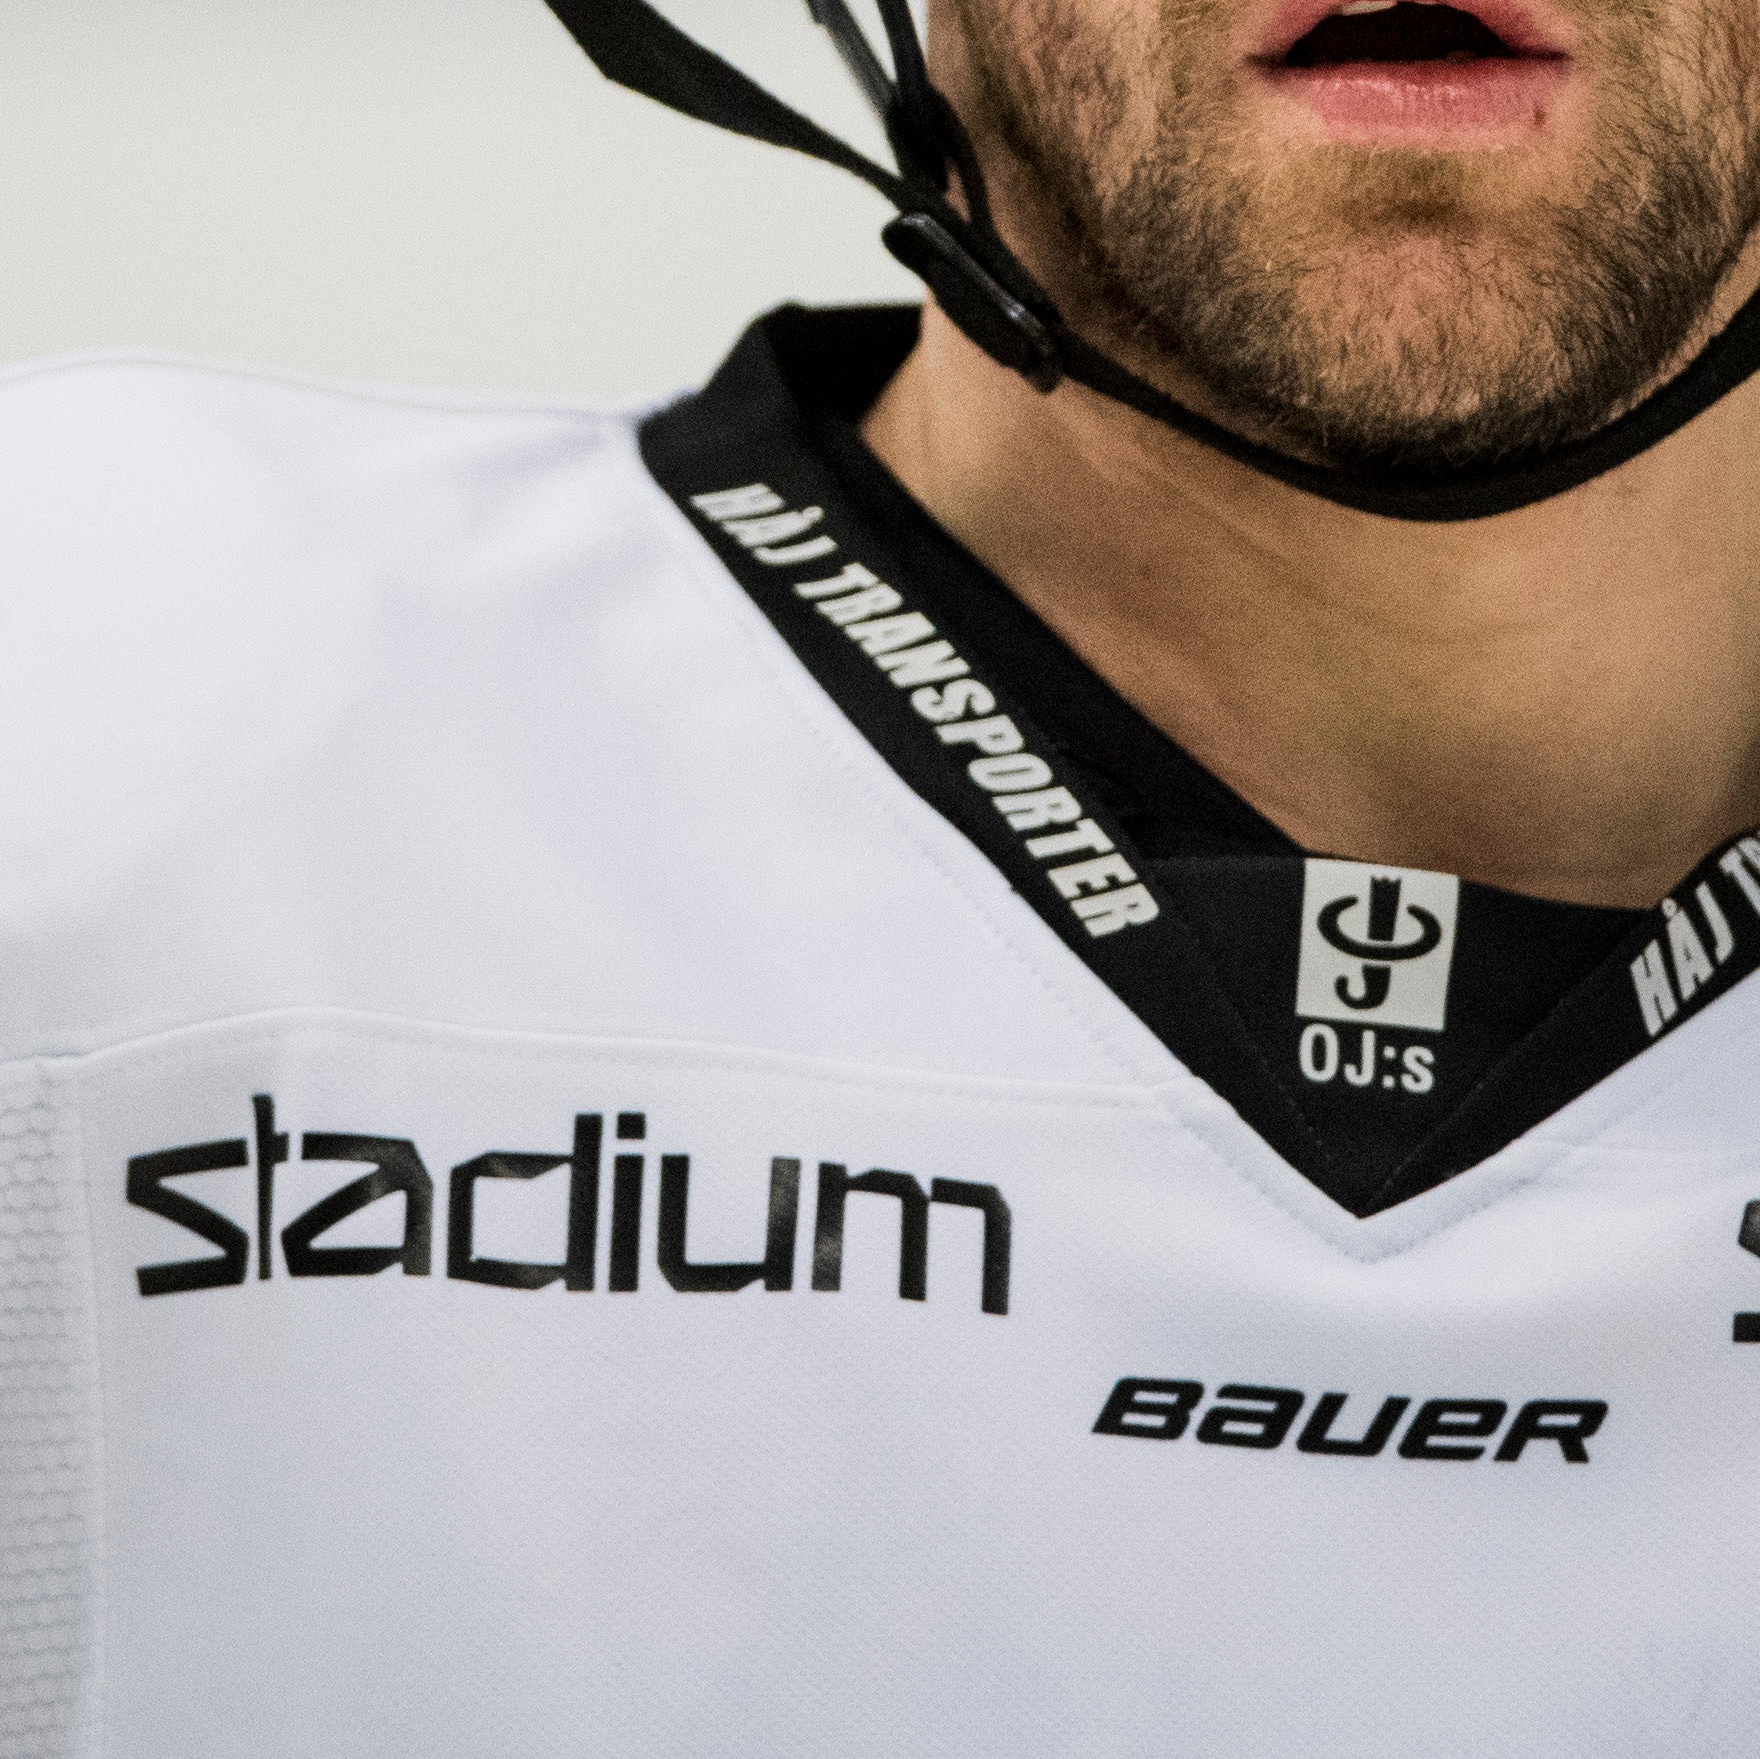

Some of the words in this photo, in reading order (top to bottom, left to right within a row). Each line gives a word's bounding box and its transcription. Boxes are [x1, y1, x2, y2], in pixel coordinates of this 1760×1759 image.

[690, 482, 838, 566] HÅJ
[794, 561, 1161, 939] TRANSPORTER
[1629, 881, 1735, 1038] HÅJ
[125, 1094, 1011, 1316] stadium
[1091, 1377, 1609, 1464] BAUER
